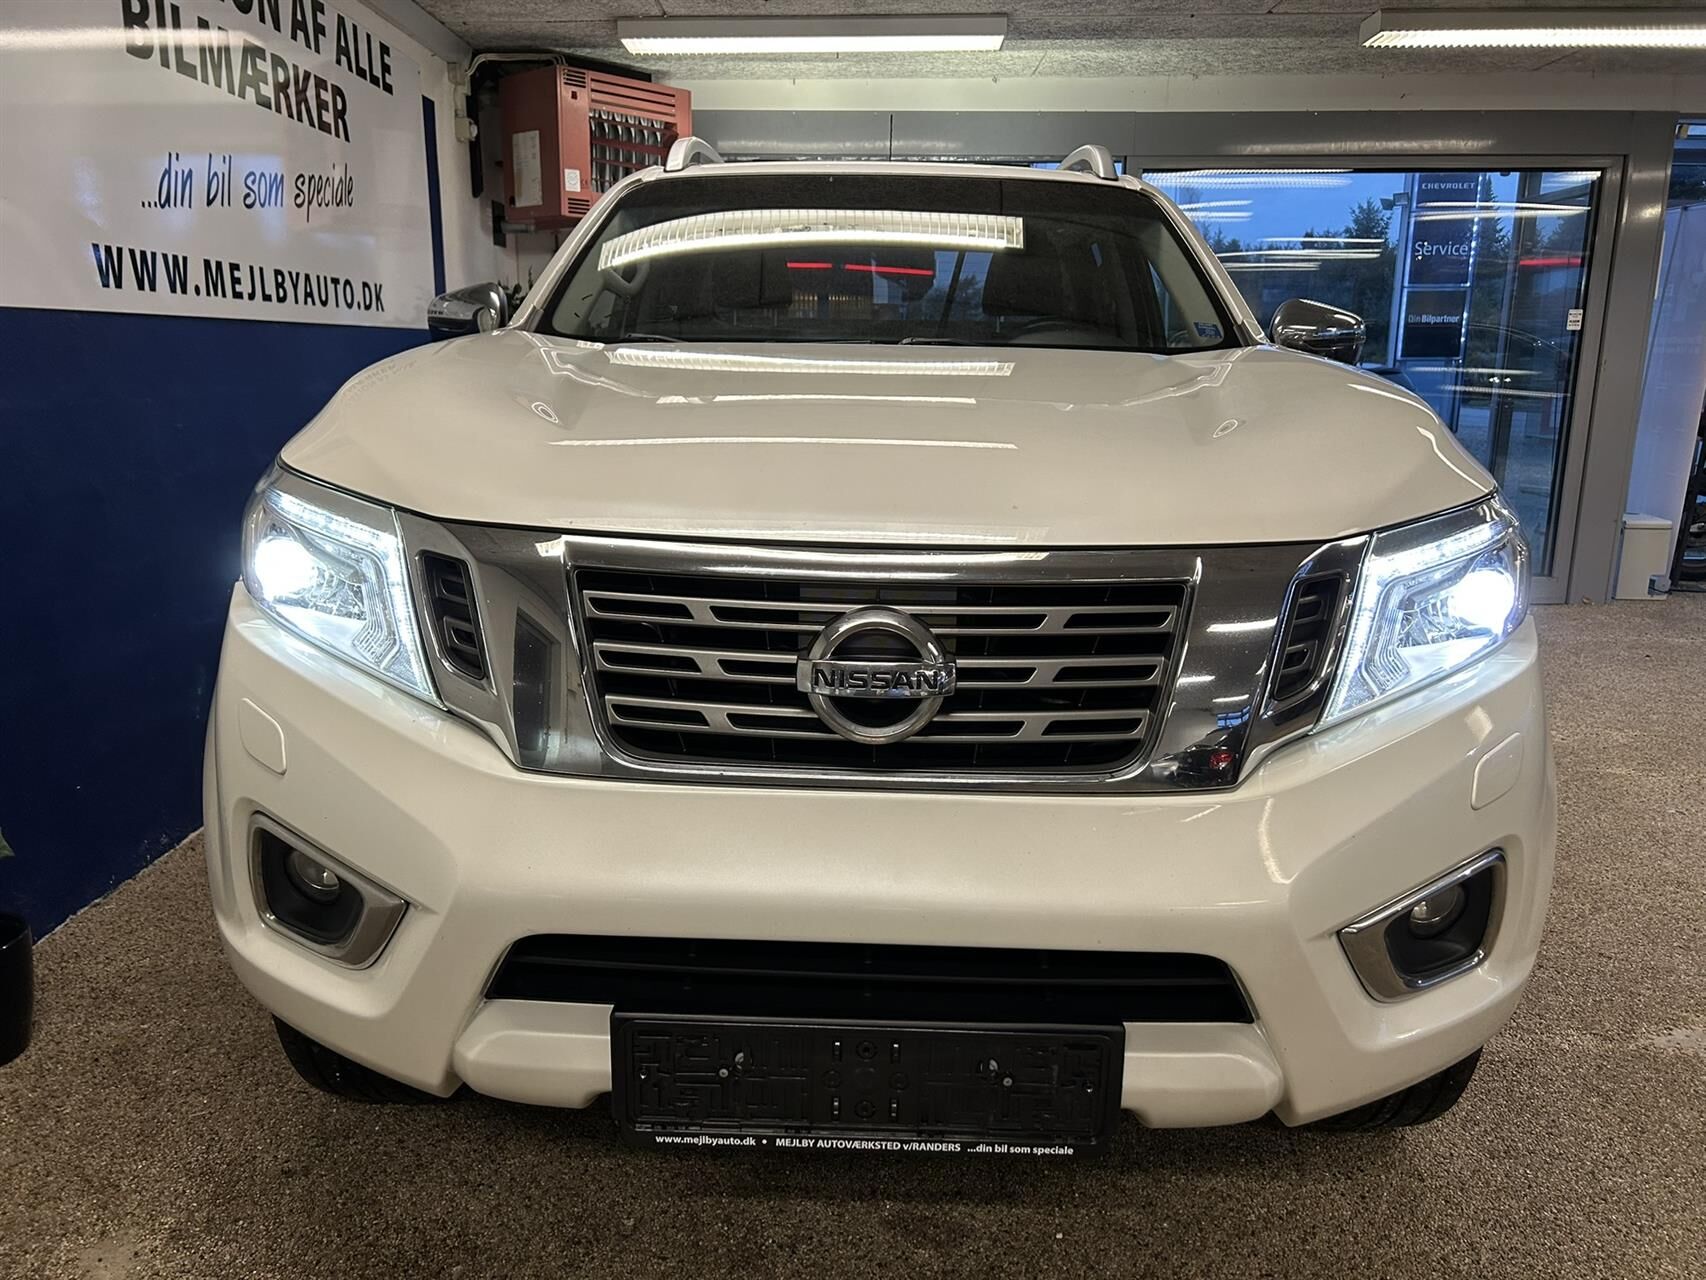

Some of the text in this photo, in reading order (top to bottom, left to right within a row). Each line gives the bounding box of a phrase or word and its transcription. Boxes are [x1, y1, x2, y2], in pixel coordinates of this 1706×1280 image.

[290, 0, 327, 55] AF
[335, 12, 394, 96] ALLE
[121, 0, 351, 143] BILMÆRKER
[141, 152, 354, 223] ...din bil som speciale
[1421, 182, 1476, 190] CHEVROLET
[1414, 241, 1469, 256] Service
[92, 243, 386, 312] WWW.MEJLBYAUTO.DK
[1421, 314, 1460, 325] Bilpartner
[812, 668, 940, 690] NISSAN
[655, 1135, 1074, 1156] www.mejlbyauto.dk MEJLBY AUTOVÆRKSTED v/RANDERS ...din bil som speciale
